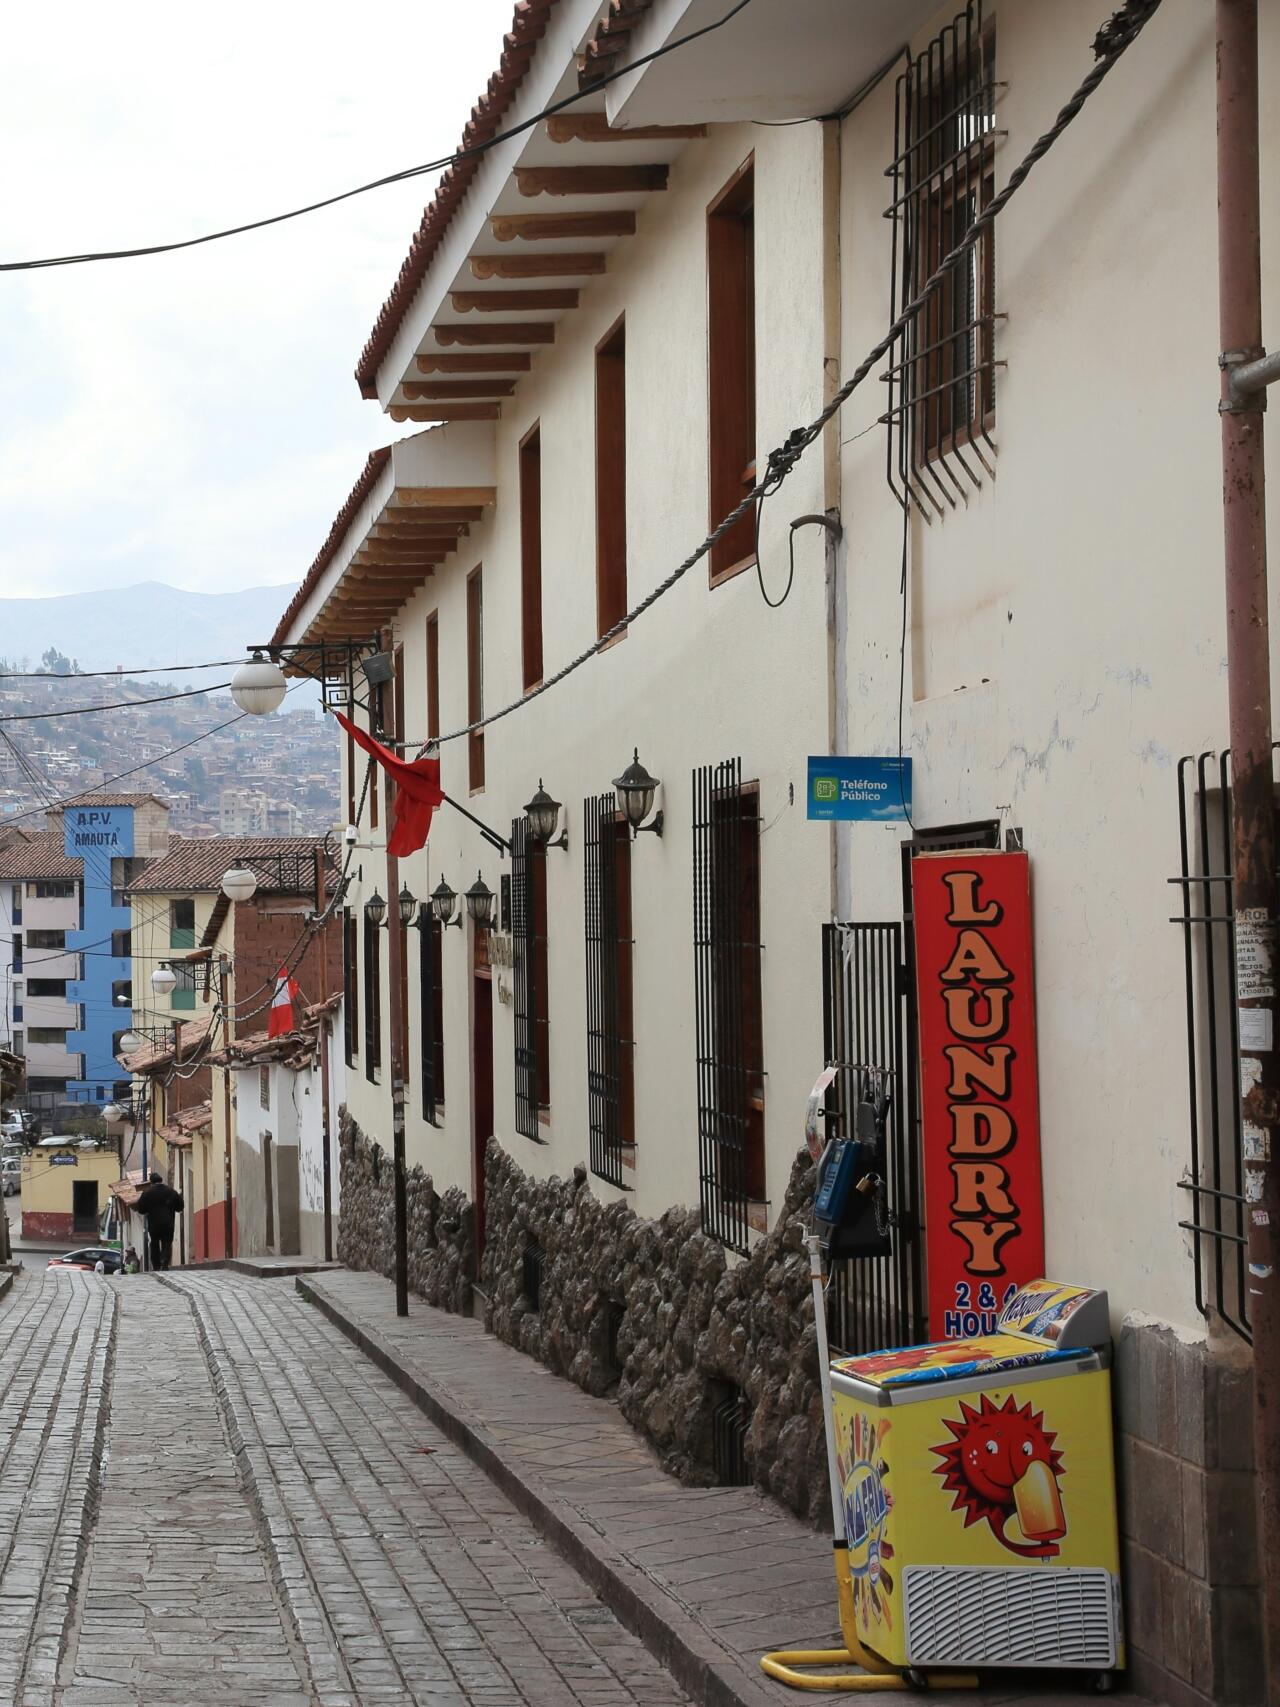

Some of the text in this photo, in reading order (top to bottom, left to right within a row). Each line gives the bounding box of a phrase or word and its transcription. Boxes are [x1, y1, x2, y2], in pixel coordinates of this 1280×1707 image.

[841, 779, 888, 790] Teléfono
[841, 791, 881, 801] Público
[77, 812, 112, 825] A.P.V.
[939, 870, 1022, 1277] LAUNDRY
[956, 1282, 970, 1308] 2
[978, 1282, 996, 1309] &
[945, 1310, 998, 1338] HOU
